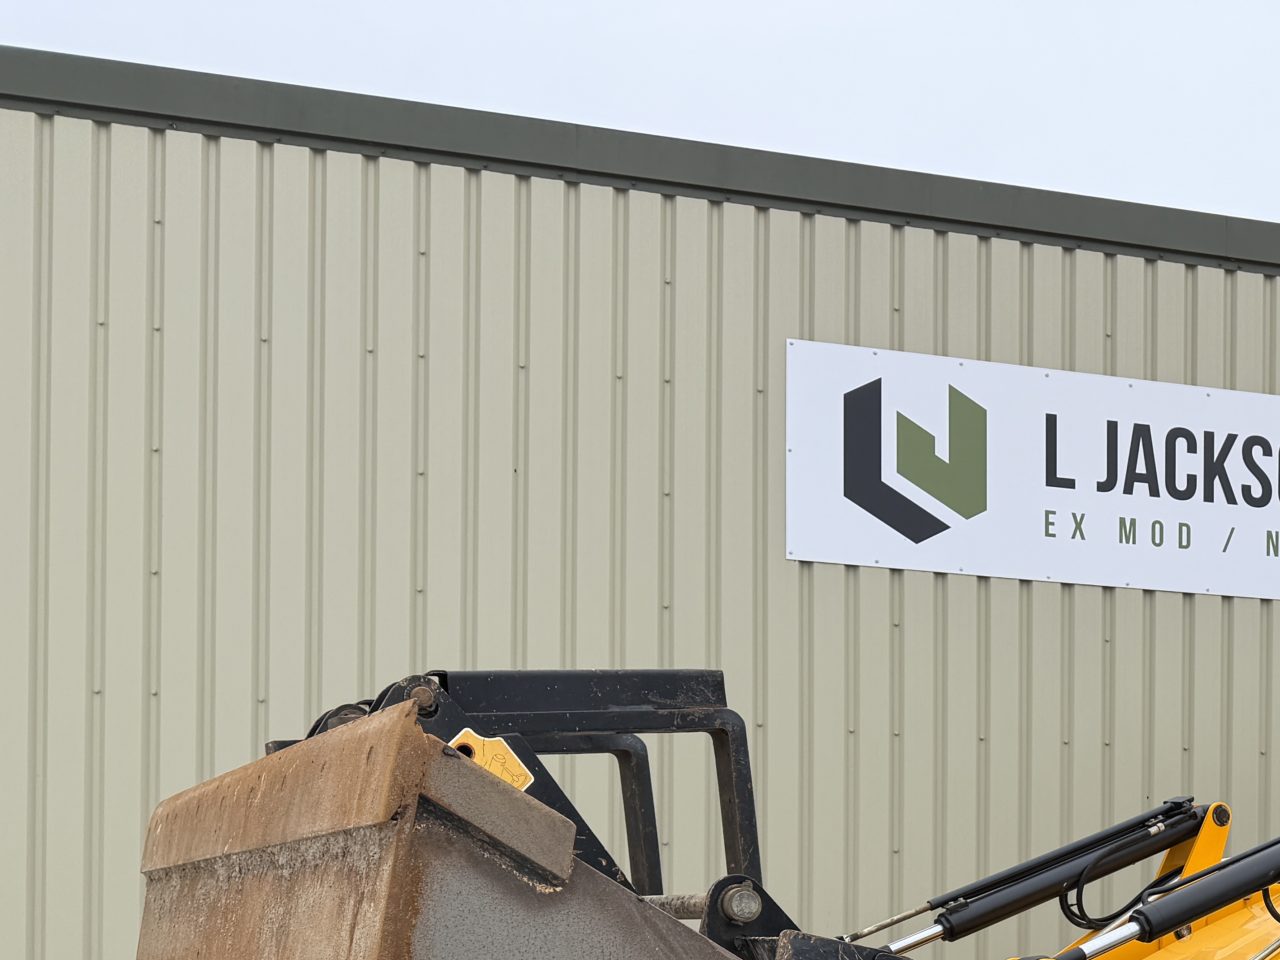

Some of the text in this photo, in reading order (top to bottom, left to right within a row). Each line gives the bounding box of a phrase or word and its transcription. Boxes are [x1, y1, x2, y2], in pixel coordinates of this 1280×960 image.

[1045, 412, 1076, 490] L
[1044, 509, 1086, 541] EX
[1118, 516, 1191, 550] MOD
[1222, 526, 1236, 553] /
